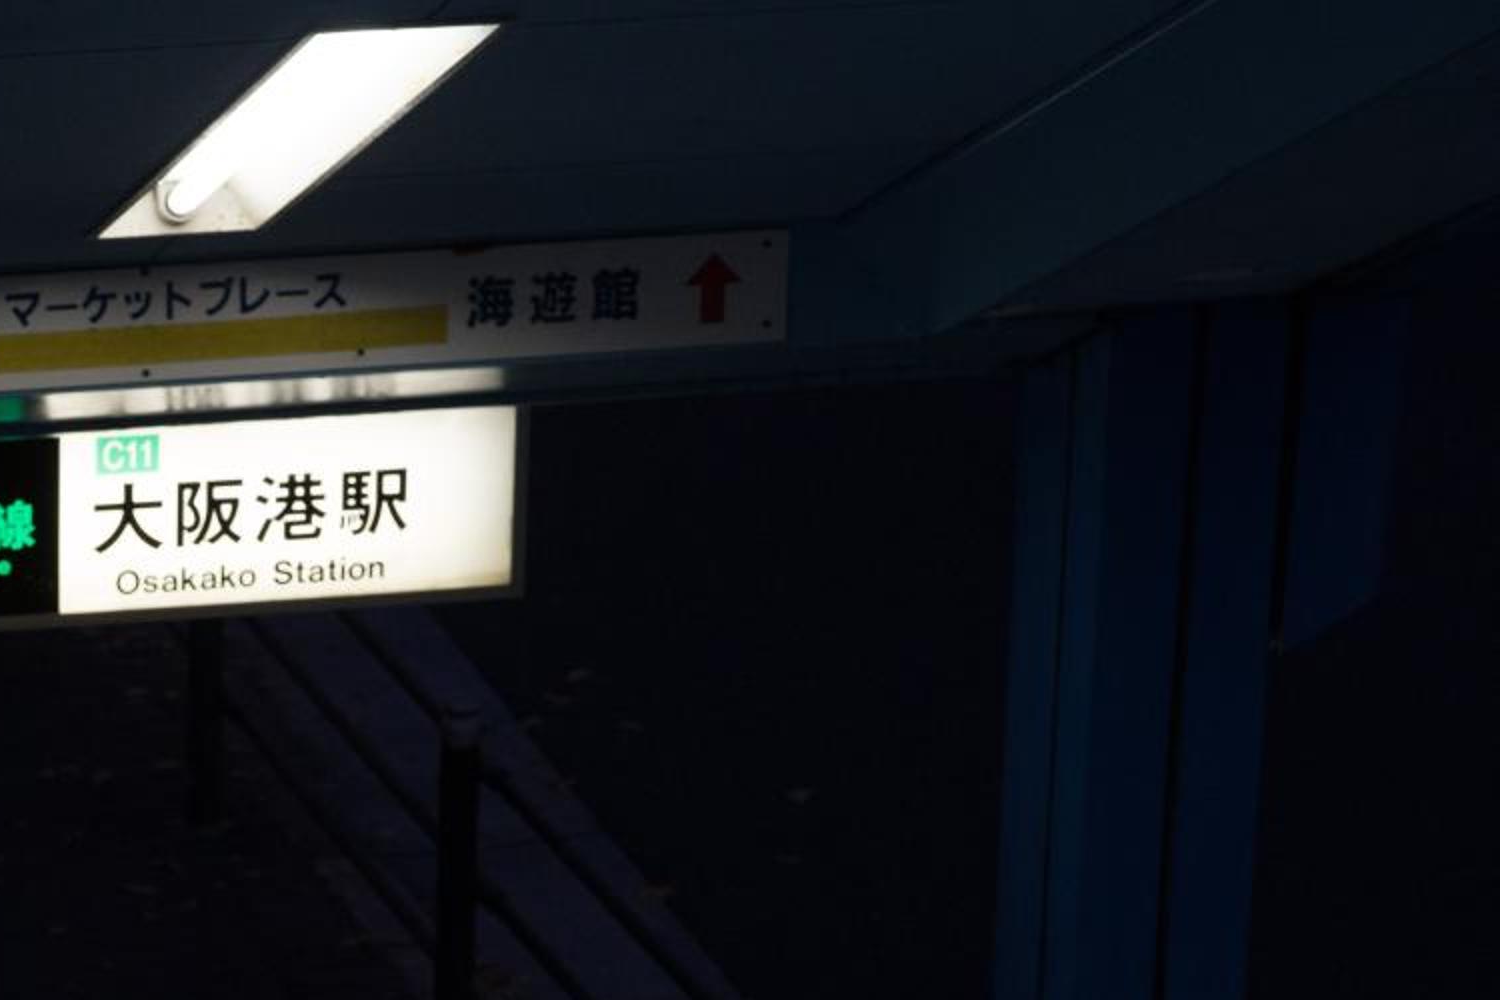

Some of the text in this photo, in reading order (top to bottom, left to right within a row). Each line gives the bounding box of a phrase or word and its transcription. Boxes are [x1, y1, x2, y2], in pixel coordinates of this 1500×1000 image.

[466, 269, 641, 328] 海遊館
[102, 439, 154, 471] C11
[95, 469, 406, 553] 大阪港駅
[116, 559, 385, 596] Osakako Station
